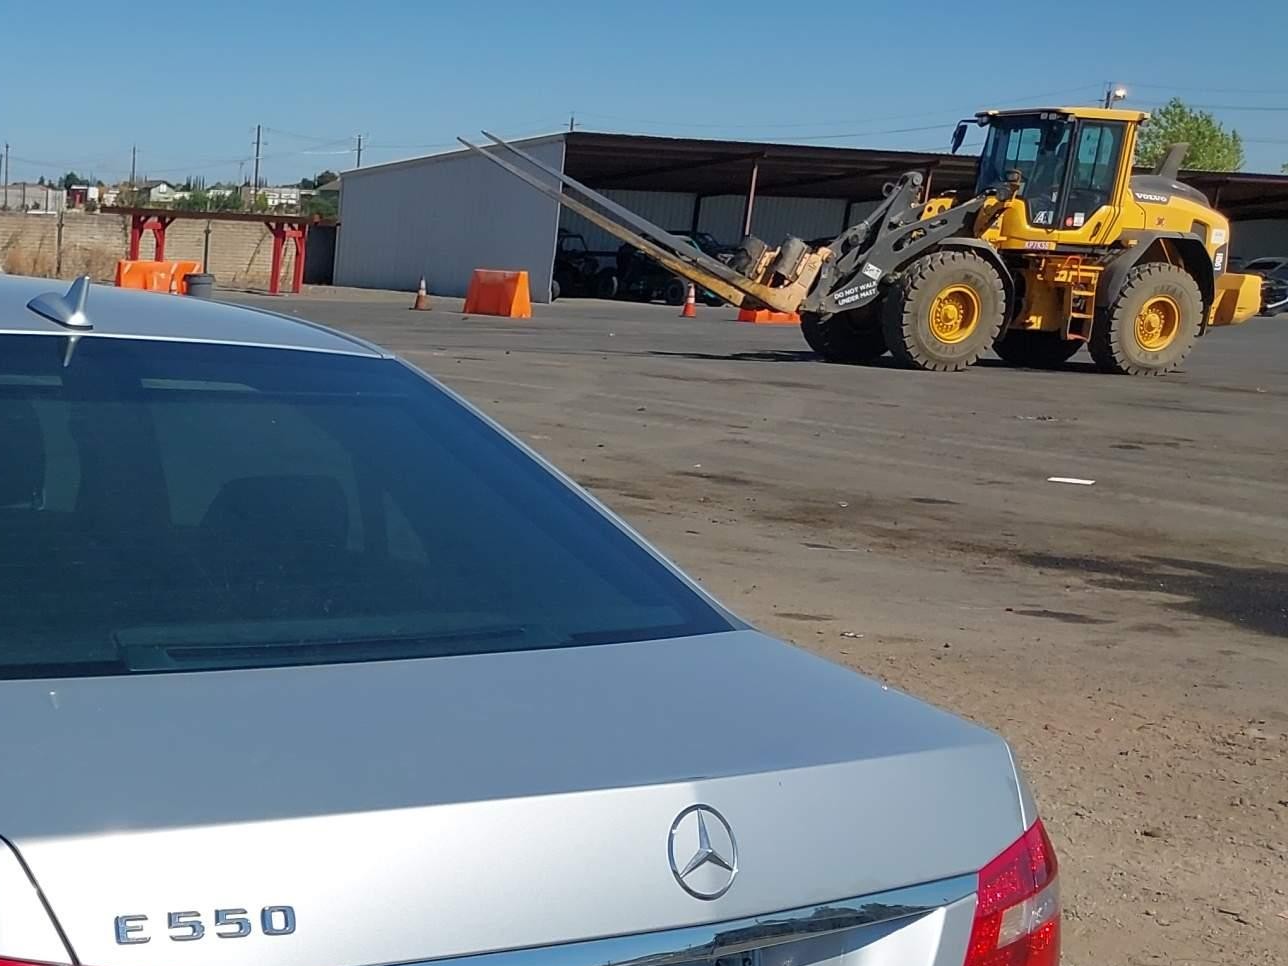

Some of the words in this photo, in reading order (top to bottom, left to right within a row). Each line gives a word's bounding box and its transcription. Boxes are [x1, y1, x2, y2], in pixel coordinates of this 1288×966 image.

[1135, 192, 1168, 202] VOLVO
[834, 291, 844, 300] DO
[845, 286, 859, 296] NOT
[859, 280, 878, 291] WALK
[838, 295, 860, 306] UNDER
[859, 288, 877, 299] MAST
[114, 914, 152, 946] E
[167, 905, 297, 942] 550
